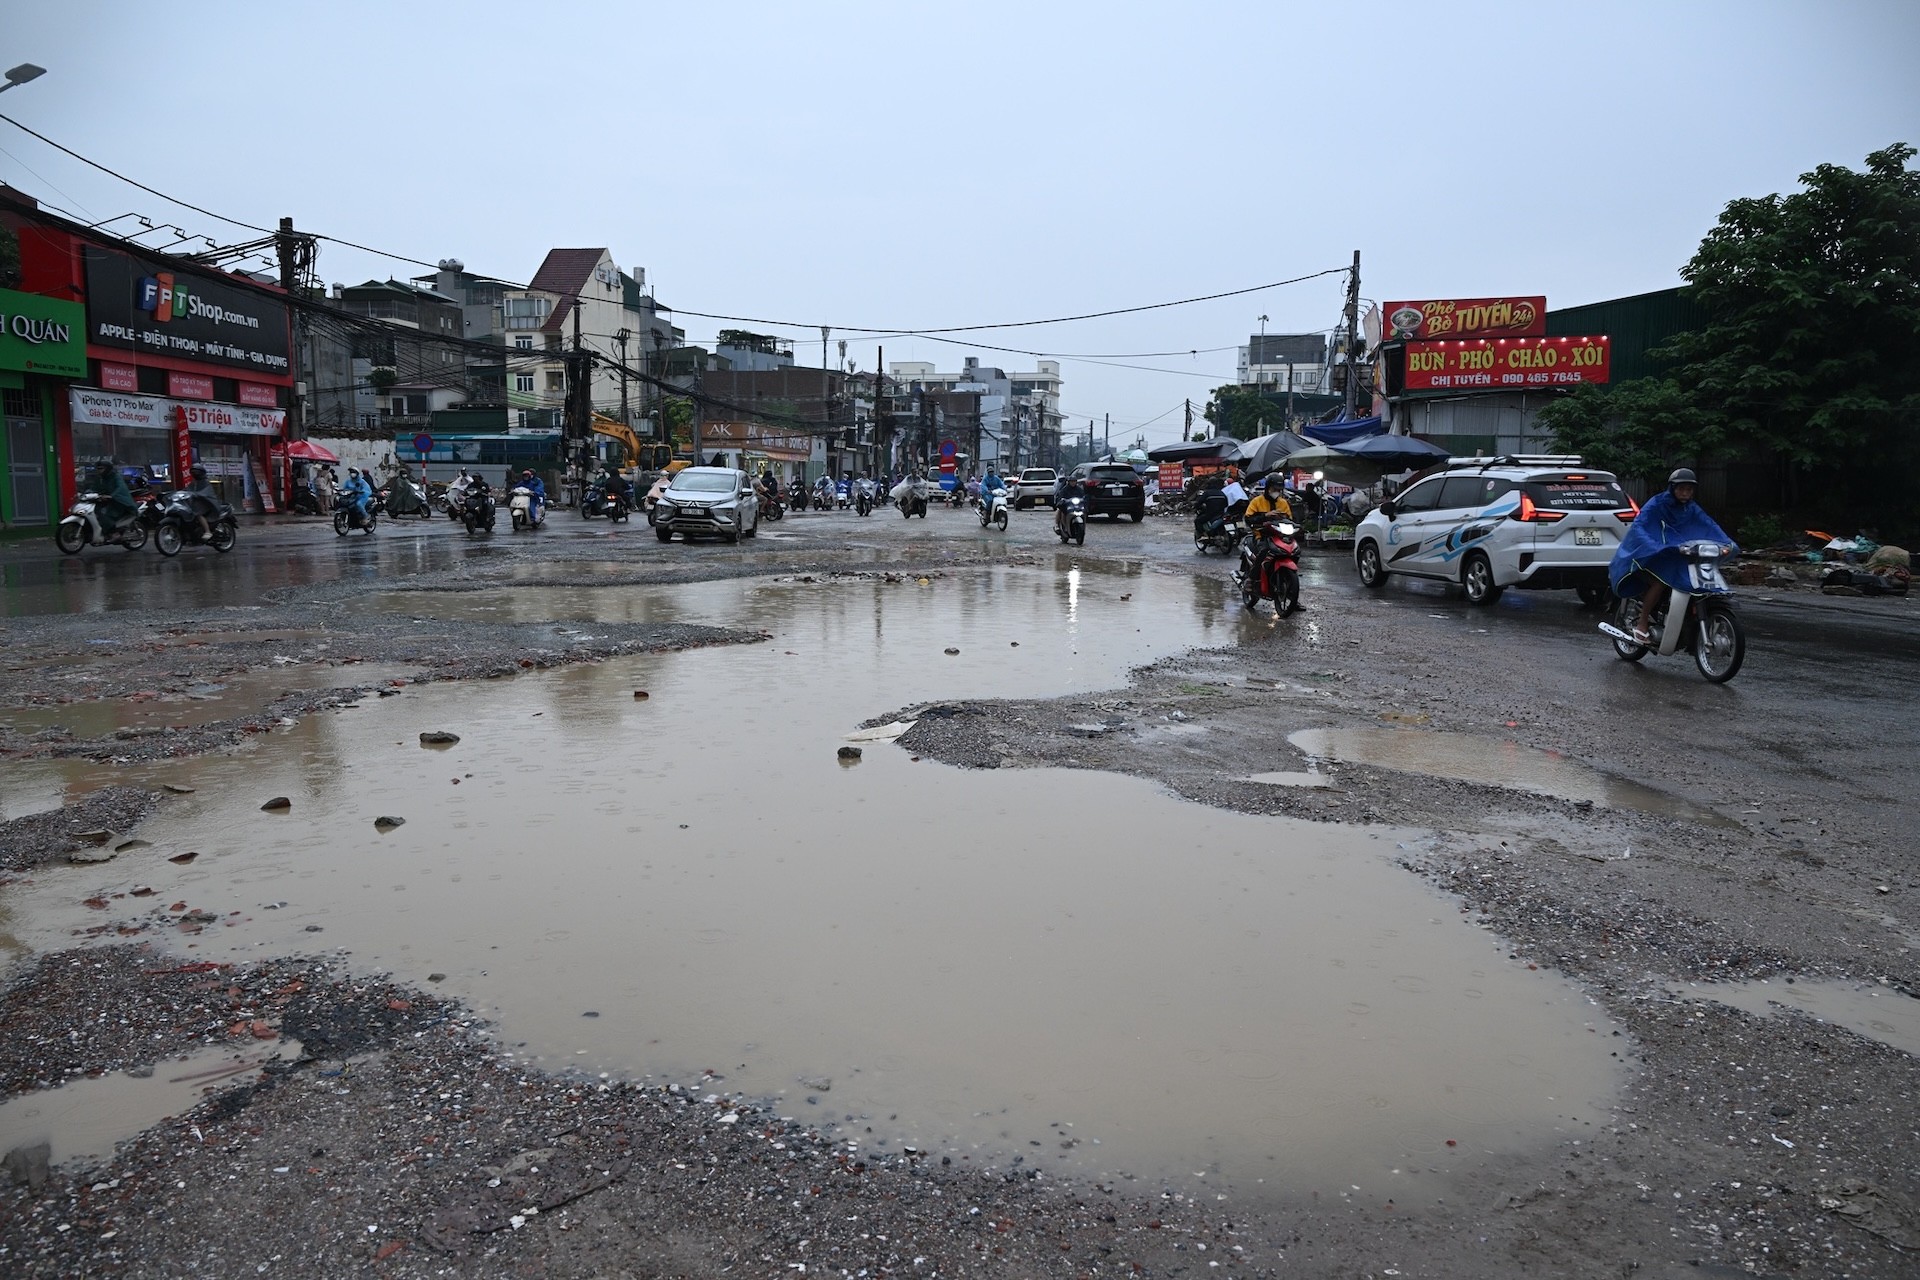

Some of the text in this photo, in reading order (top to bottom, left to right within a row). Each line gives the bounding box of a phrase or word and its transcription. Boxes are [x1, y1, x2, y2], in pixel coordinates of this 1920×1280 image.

[145, 284, 259, 329] FPT Shop.com.vn
[1455, 300, 1512, 332] TUYẾN
[12, 315, 70, 344] QUÁN
[1426, 316, 1454, 332] Bò
[100, 322, 136, 341] APPLE
[143, 329, 168, 349] ĐIỆN
[170, 336, 199, 356] THOẠI
[206, 341, 224, 356] MÁY
[225, 344, 245, 360] TÍNH
[250, 352, 266, 365] GIA
[266, 355, 288, 369] DỤNG
[1408, 348, 1446, 372] BÚN
[1459, 342, 1495, 370] PHỞ
[1508, 343, 1558, 368] CHÁO
[1570, 342, 1604, 367] XÔI
[1431, 376, 1451, 387] CHỊ
[1454, 372, 1491, 384] TUYẾN
[1502, 373, 1524, 384] 090
[1526, 373, 1549, 383] 465
[1552, 372, 1582, 382] 7645
[82, 394, 154, 411] iPhone 17 Pro Max
[134, 414, 150, 423] ngay
[189, 408, 232, 429] 5 Triệu
[261, 414, 280, 429] 0%
[706, 424, 733, 436] AK
